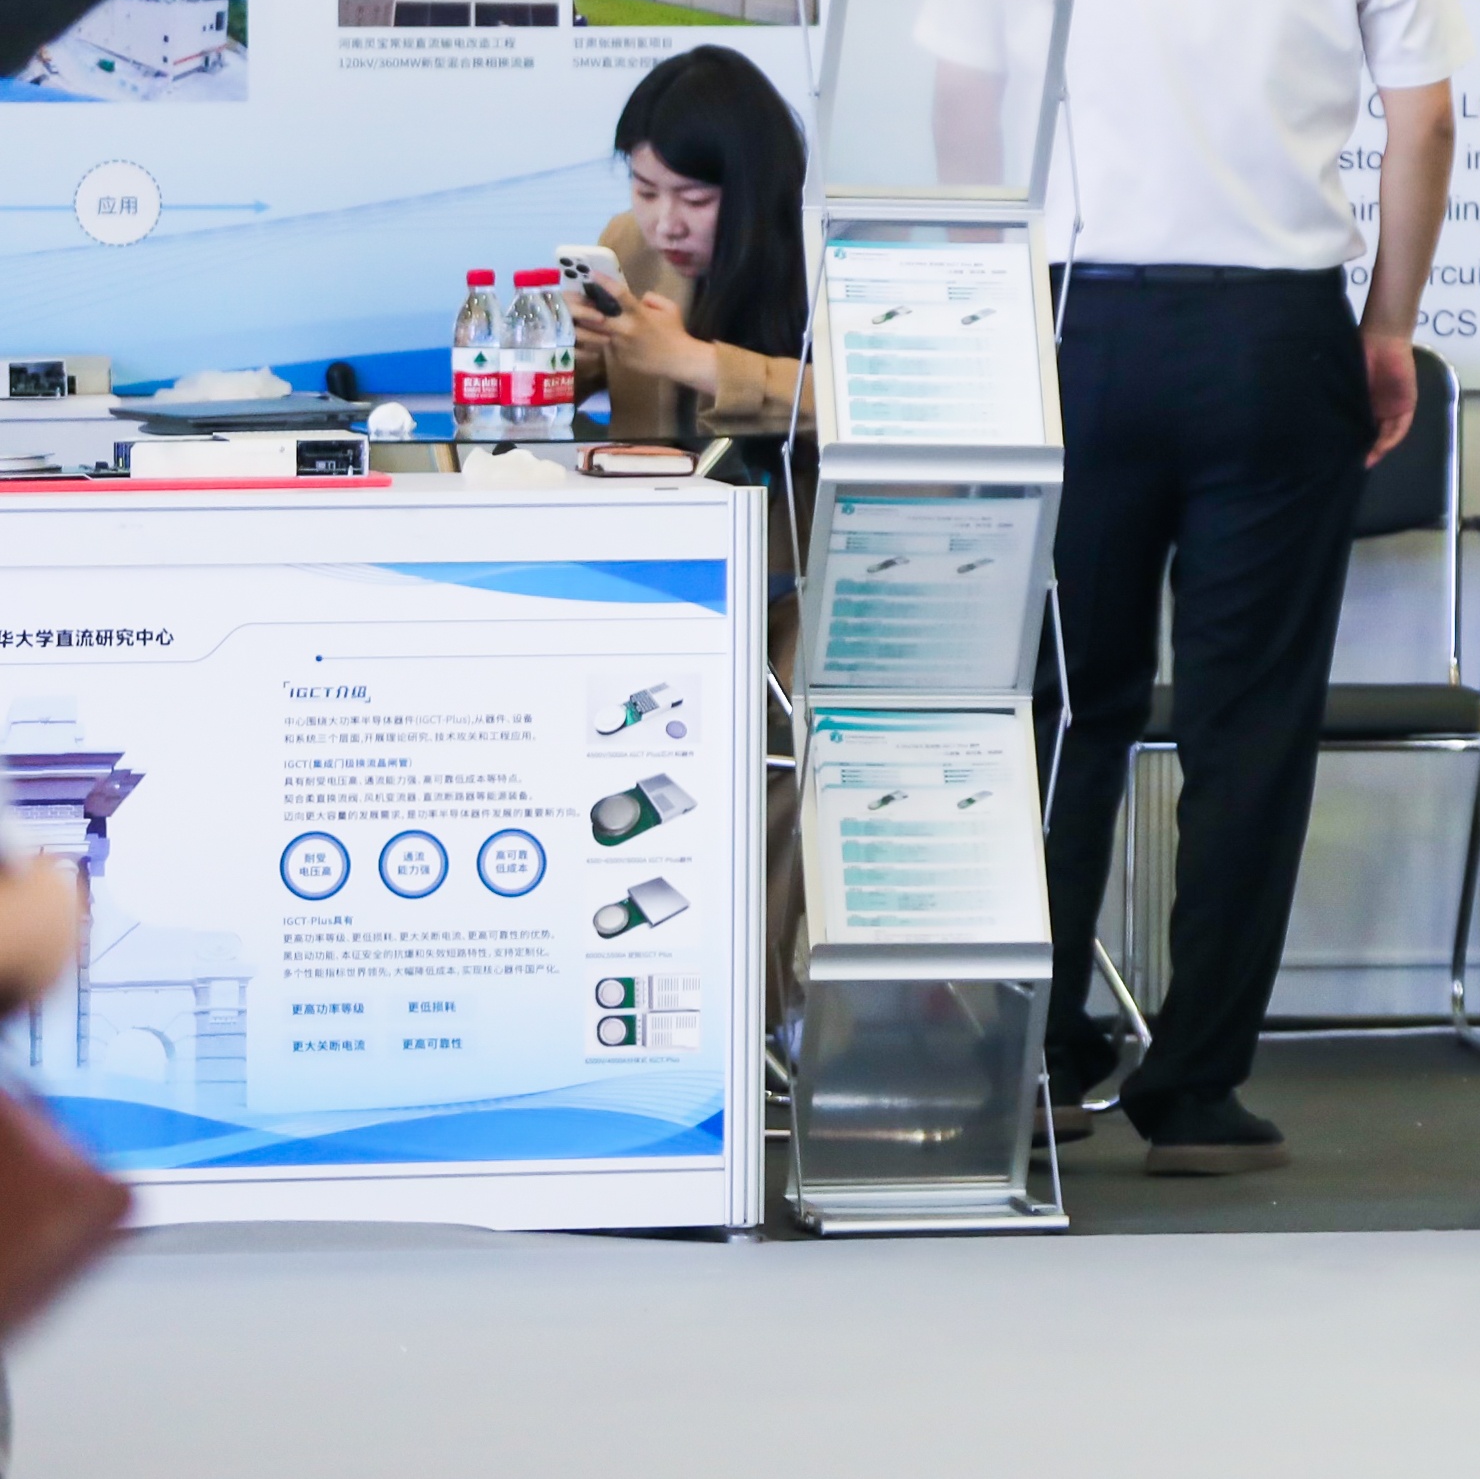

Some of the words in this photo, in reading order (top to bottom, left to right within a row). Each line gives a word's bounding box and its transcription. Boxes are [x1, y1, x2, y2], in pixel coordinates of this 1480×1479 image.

[96, 195, 140, 218] 应用
[495, 862, 529, 875] 低成本
[291, 1002, 366, 1016] 更高功率等级
[292, 1039, 367, 1053] 更大关断电流
[402, 1037, 464, 1051] 更高可靠性
